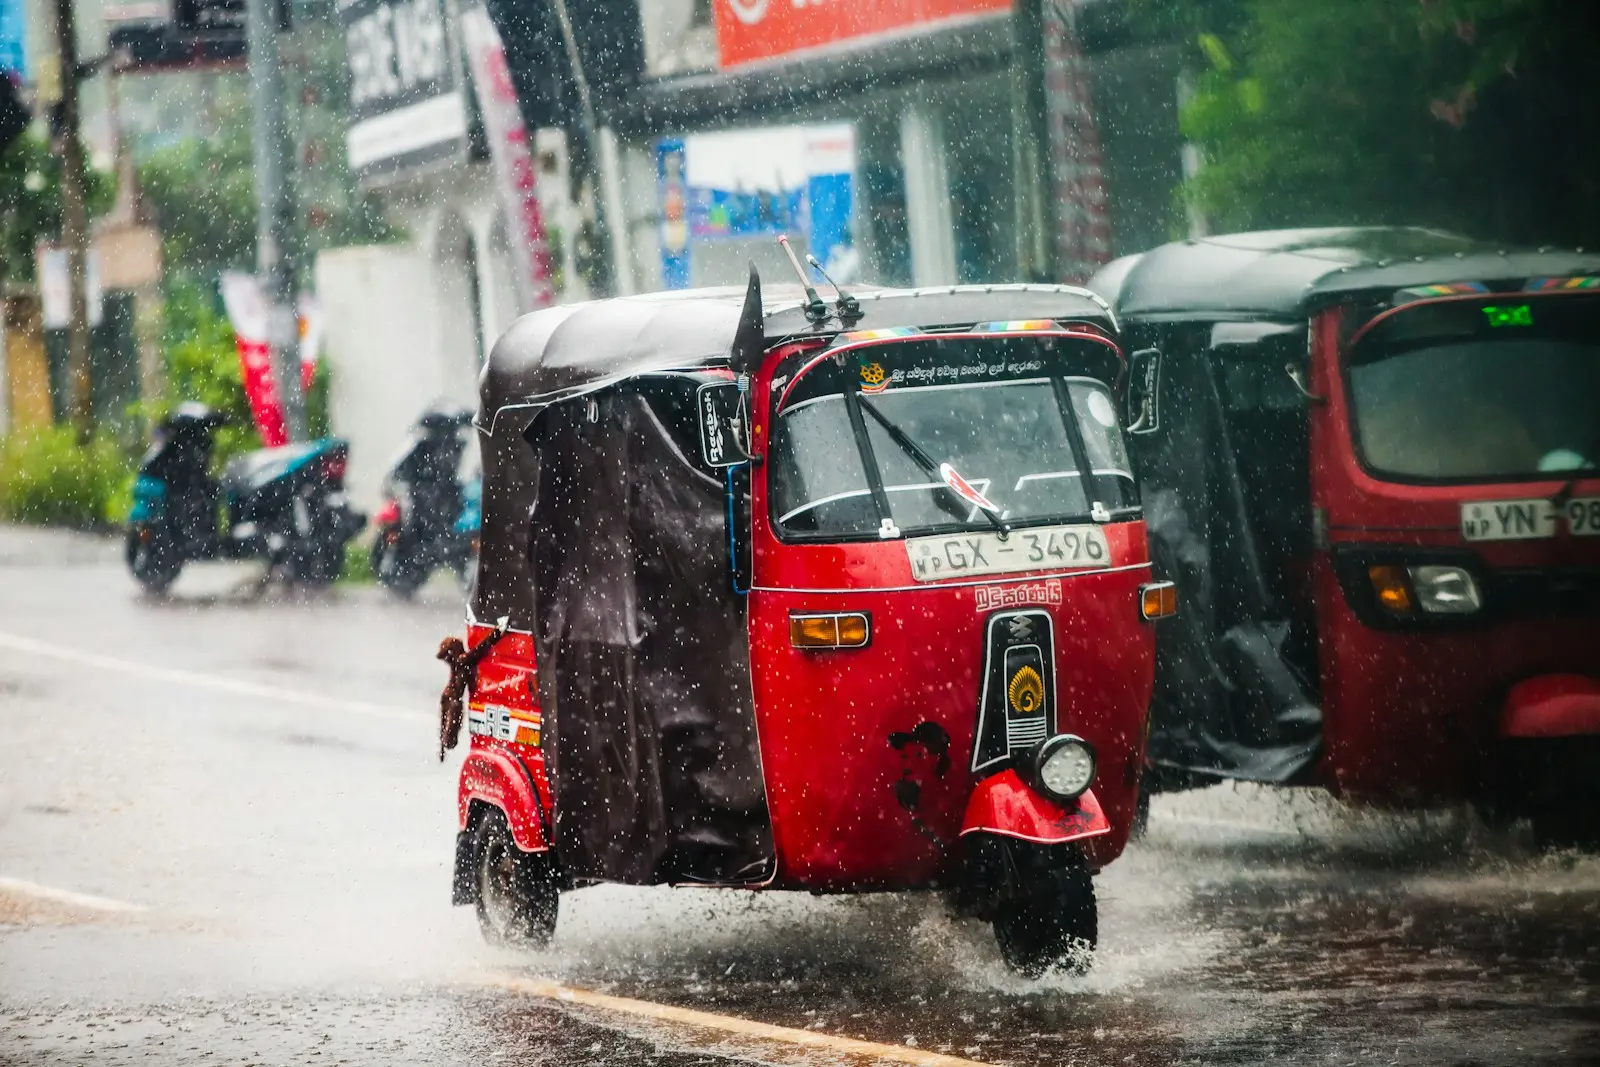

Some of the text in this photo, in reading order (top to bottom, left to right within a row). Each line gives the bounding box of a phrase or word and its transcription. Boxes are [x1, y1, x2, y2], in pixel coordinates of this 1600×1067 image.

[704, 392, 718, 462] Reebok
[1495, 503, 1536, 534] YN
[915, 556, 941, 576] WP
[944, 539, 989, 570] GX
[1023, 531, 1101, 562] 3496
